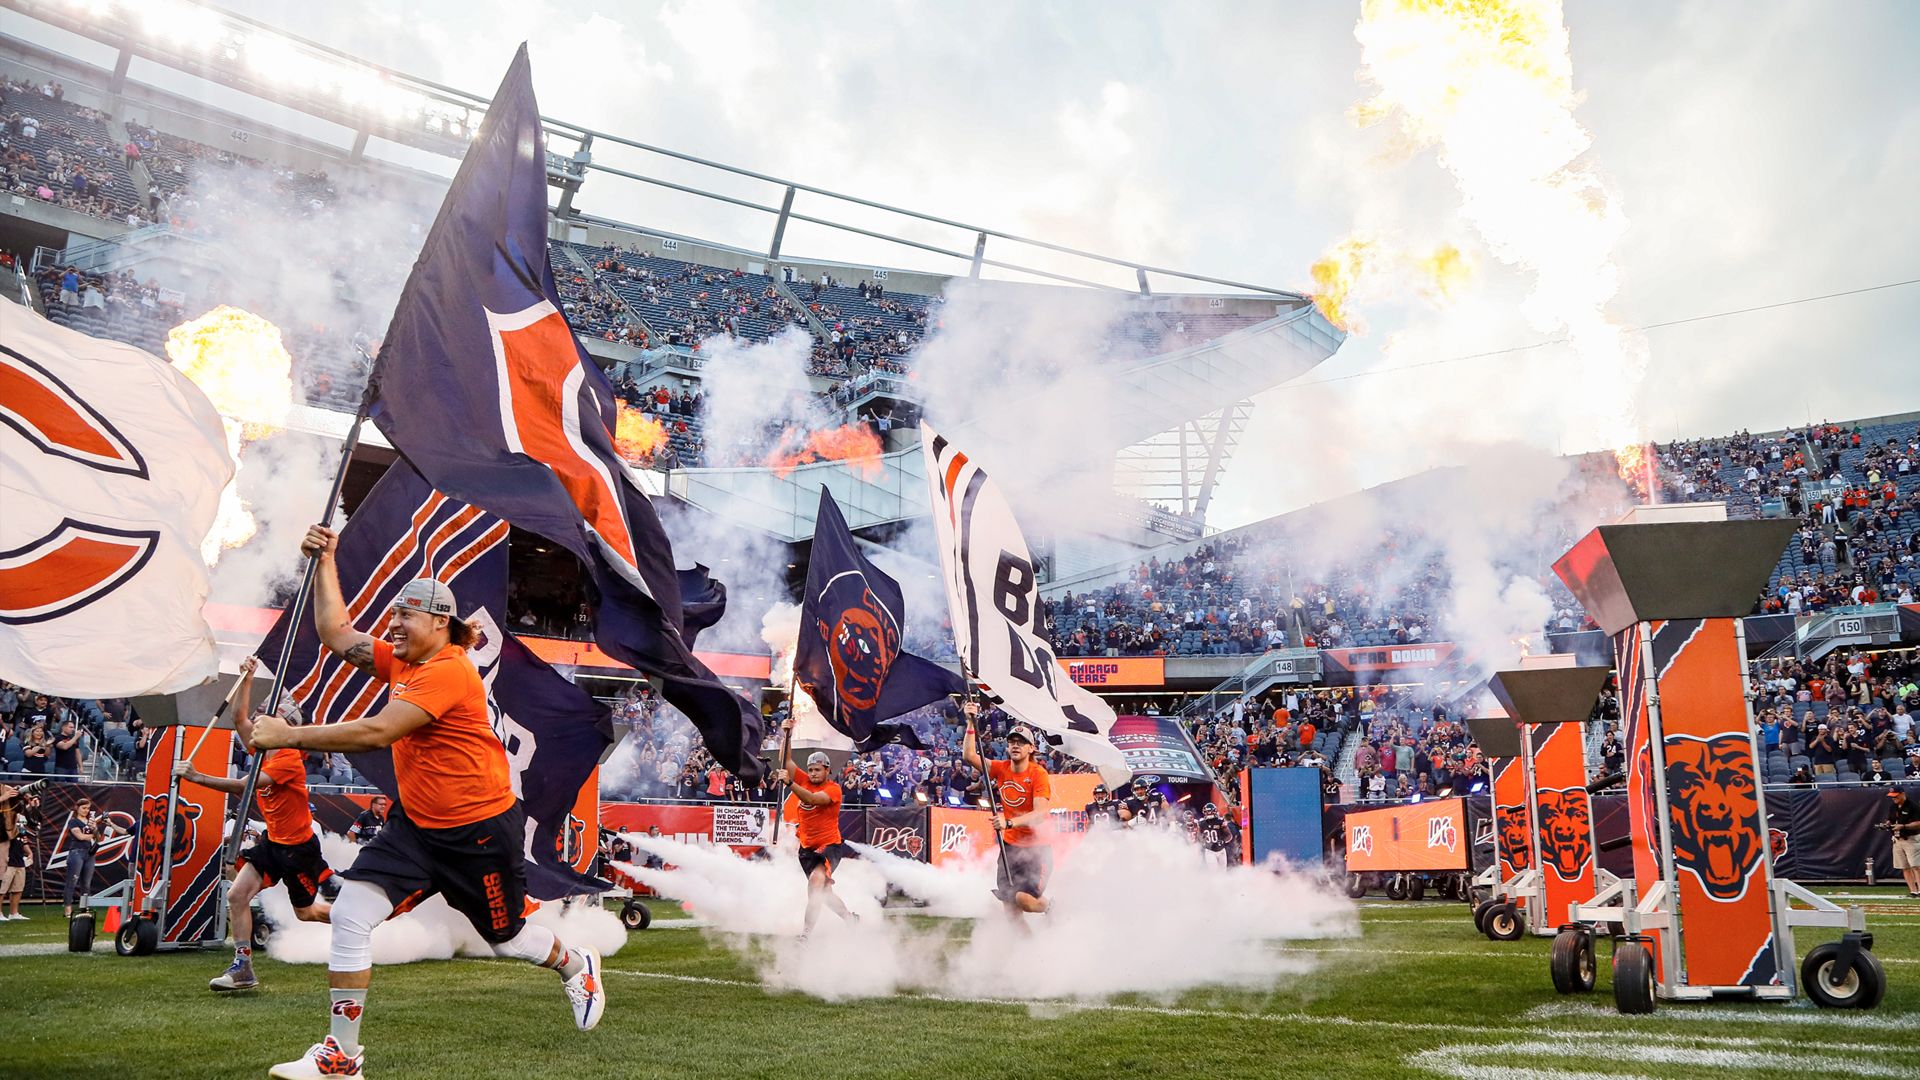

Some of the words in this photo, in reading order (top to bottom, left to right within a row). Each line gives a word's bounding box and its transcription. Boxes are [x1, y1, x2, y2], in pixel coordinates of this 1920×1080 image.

[663, 240, 677, 249] 444
[874, 270, 887, 279] 445
[579, 614, 587, 622] 23
[1840, 621, 1861, 632] 150
[1322, 637, 1331, 647] 95
[1349, 652, 1388, 666] BEAR
[1392, 650, 1436, 664] DOWN
[1070, 664, 1118, 674] CHICAGO
[1277, 662, 1293, 672] 148
[1070, 674, 1107, 684] BEARS
[1124, 750, 1182, 758] UILT
[1606, 744, 1617, 754] 24
[1127, 762, 1188, 770] OUGH
[1168, 776, 1188, 784] TOUGH
[1326, 785, 1337, 794] 22
[871, 827, 918, 852] 100
[1203, 829, 1218, 843] 30
[483, 872, 510, 930] BEARS
